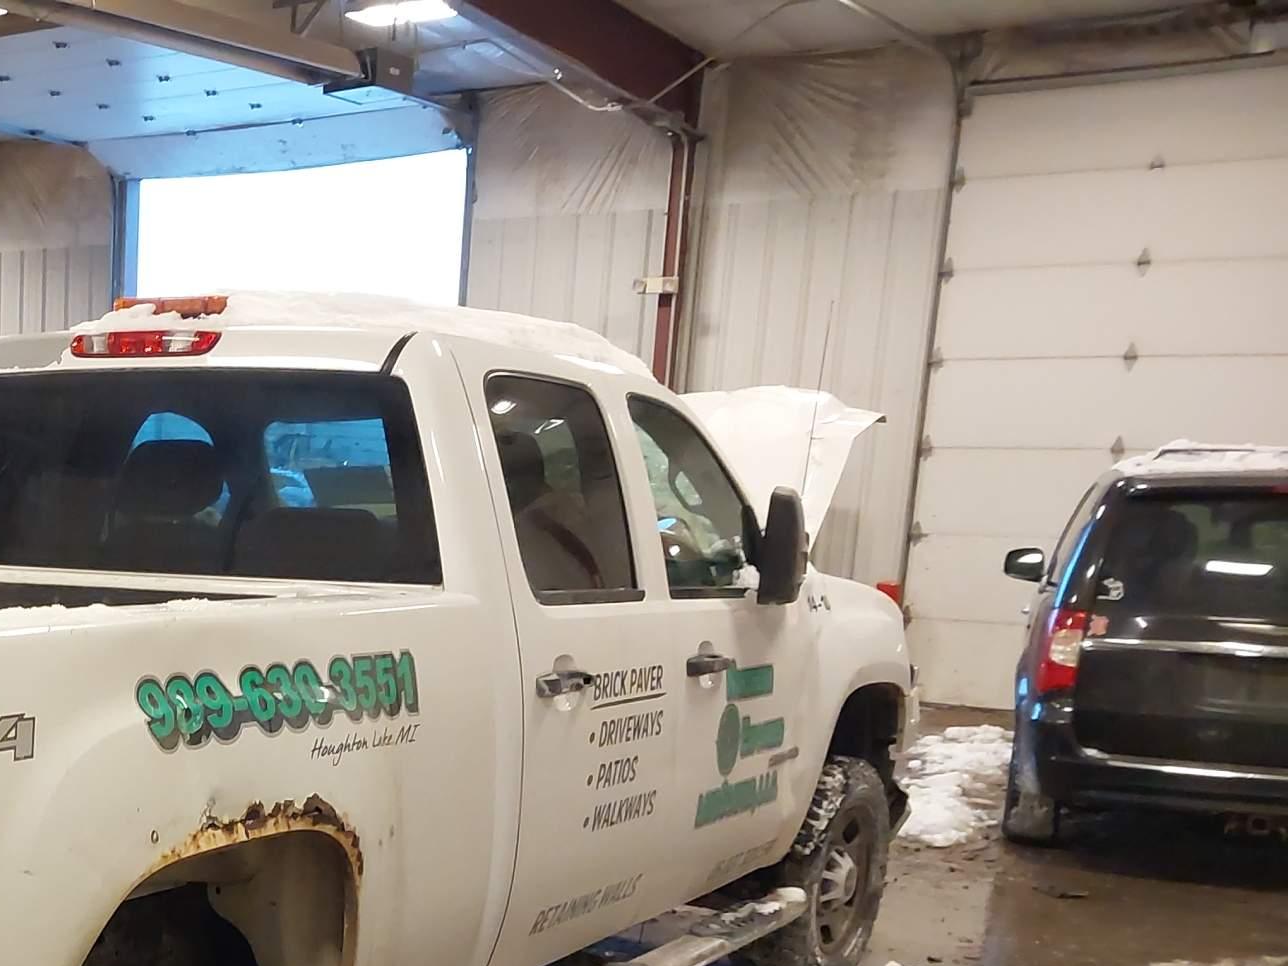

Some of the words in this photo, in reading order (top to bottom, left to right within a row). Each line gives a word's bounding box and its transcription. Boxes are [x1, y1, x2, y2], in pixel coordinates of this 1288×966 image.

[593, 671, 628, 701] BRICK
[630, 664, 664, 692] PAVER
[311, 733, 369, 767] Houghton
[394, 724, 421, 745] MI
[598, 709, 664, 748] DRIVEWAYS
[596, 755, 639, 790] PATIOS
[591, 789, 657, 832] WALKWAYS
